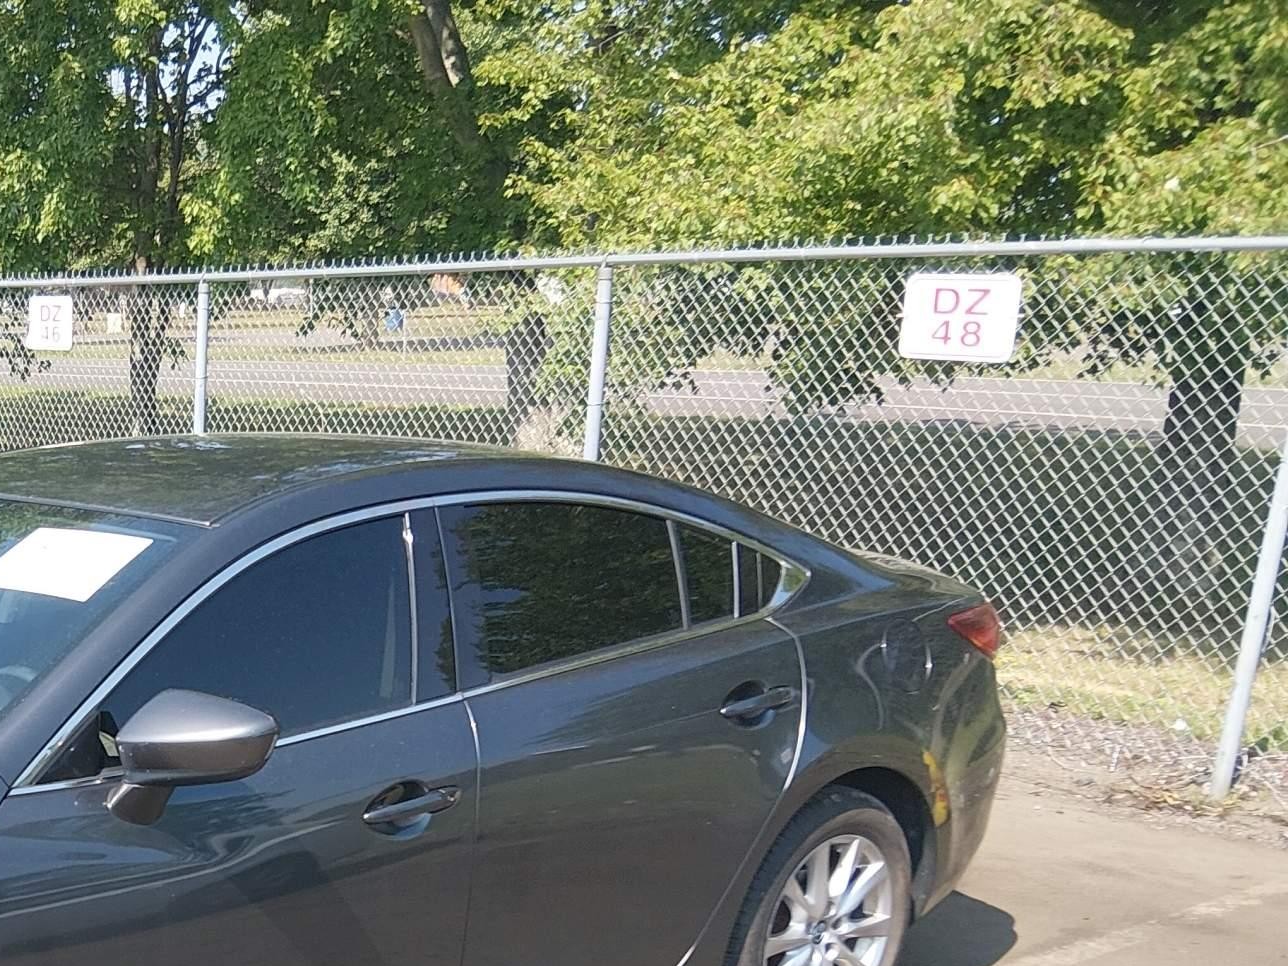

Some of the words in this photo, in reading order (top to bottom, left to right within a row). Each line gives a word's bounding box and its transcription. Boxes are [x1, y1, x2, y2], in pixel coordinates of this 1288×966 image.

[40, 304, 62, 322] DZ
[933, 288, 991, 315] DZ
[931, 320, 981, 347] 48
